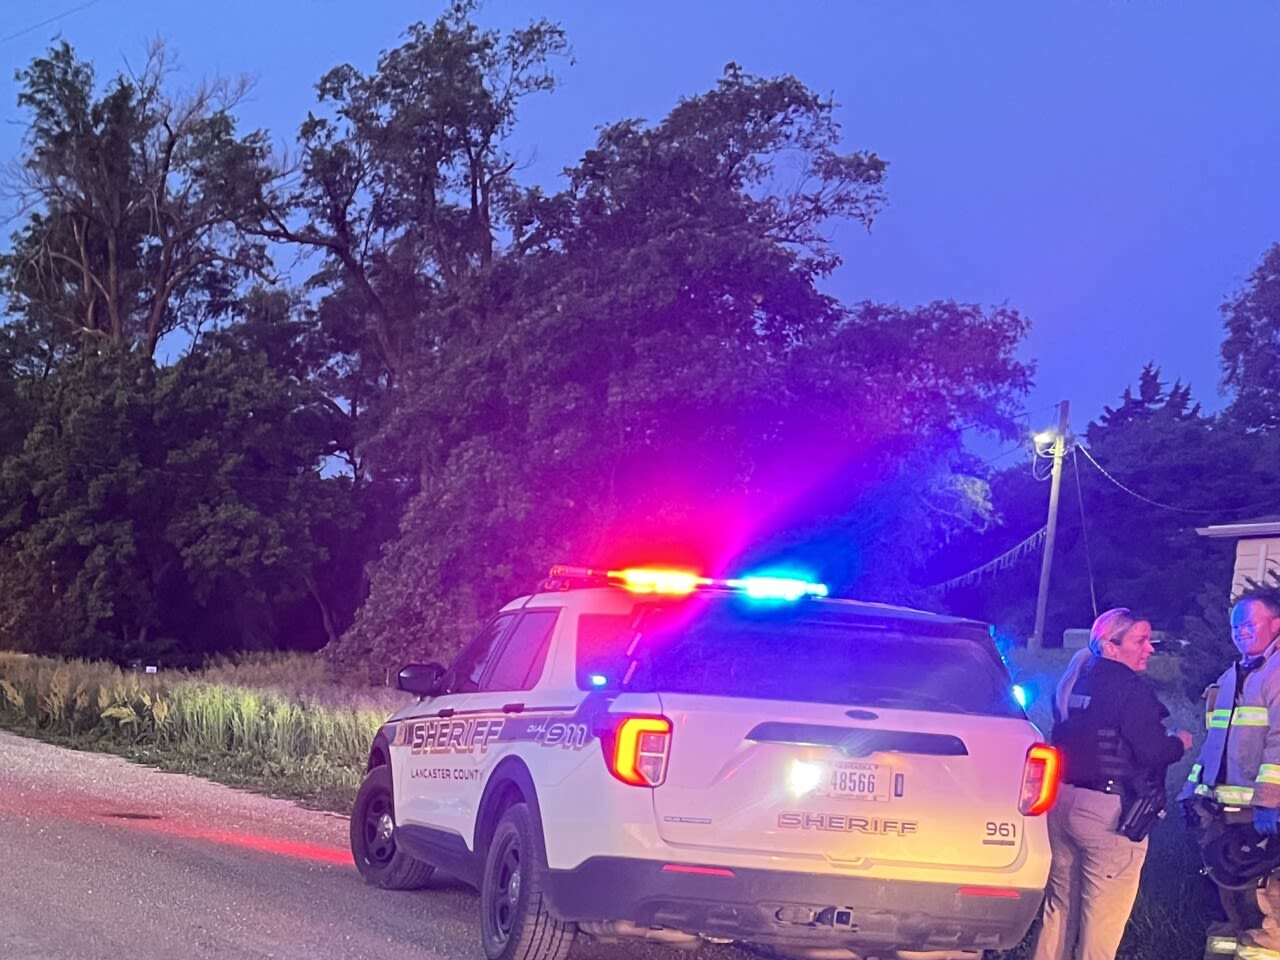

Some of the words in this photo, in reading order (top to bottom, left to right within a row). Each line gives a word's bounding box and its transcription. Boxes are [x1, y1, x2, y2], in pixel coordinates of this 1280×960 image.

[412, 719, 506, 753] SHERIFF
[544, 723, 588, 749] 911
[411, 769, 451, 780] LANCASTER
[453, 769, 485, 781] COUNTY
[778, 811, 918, 836] SHERIFF
[986, 821, 1016, 838] 961
